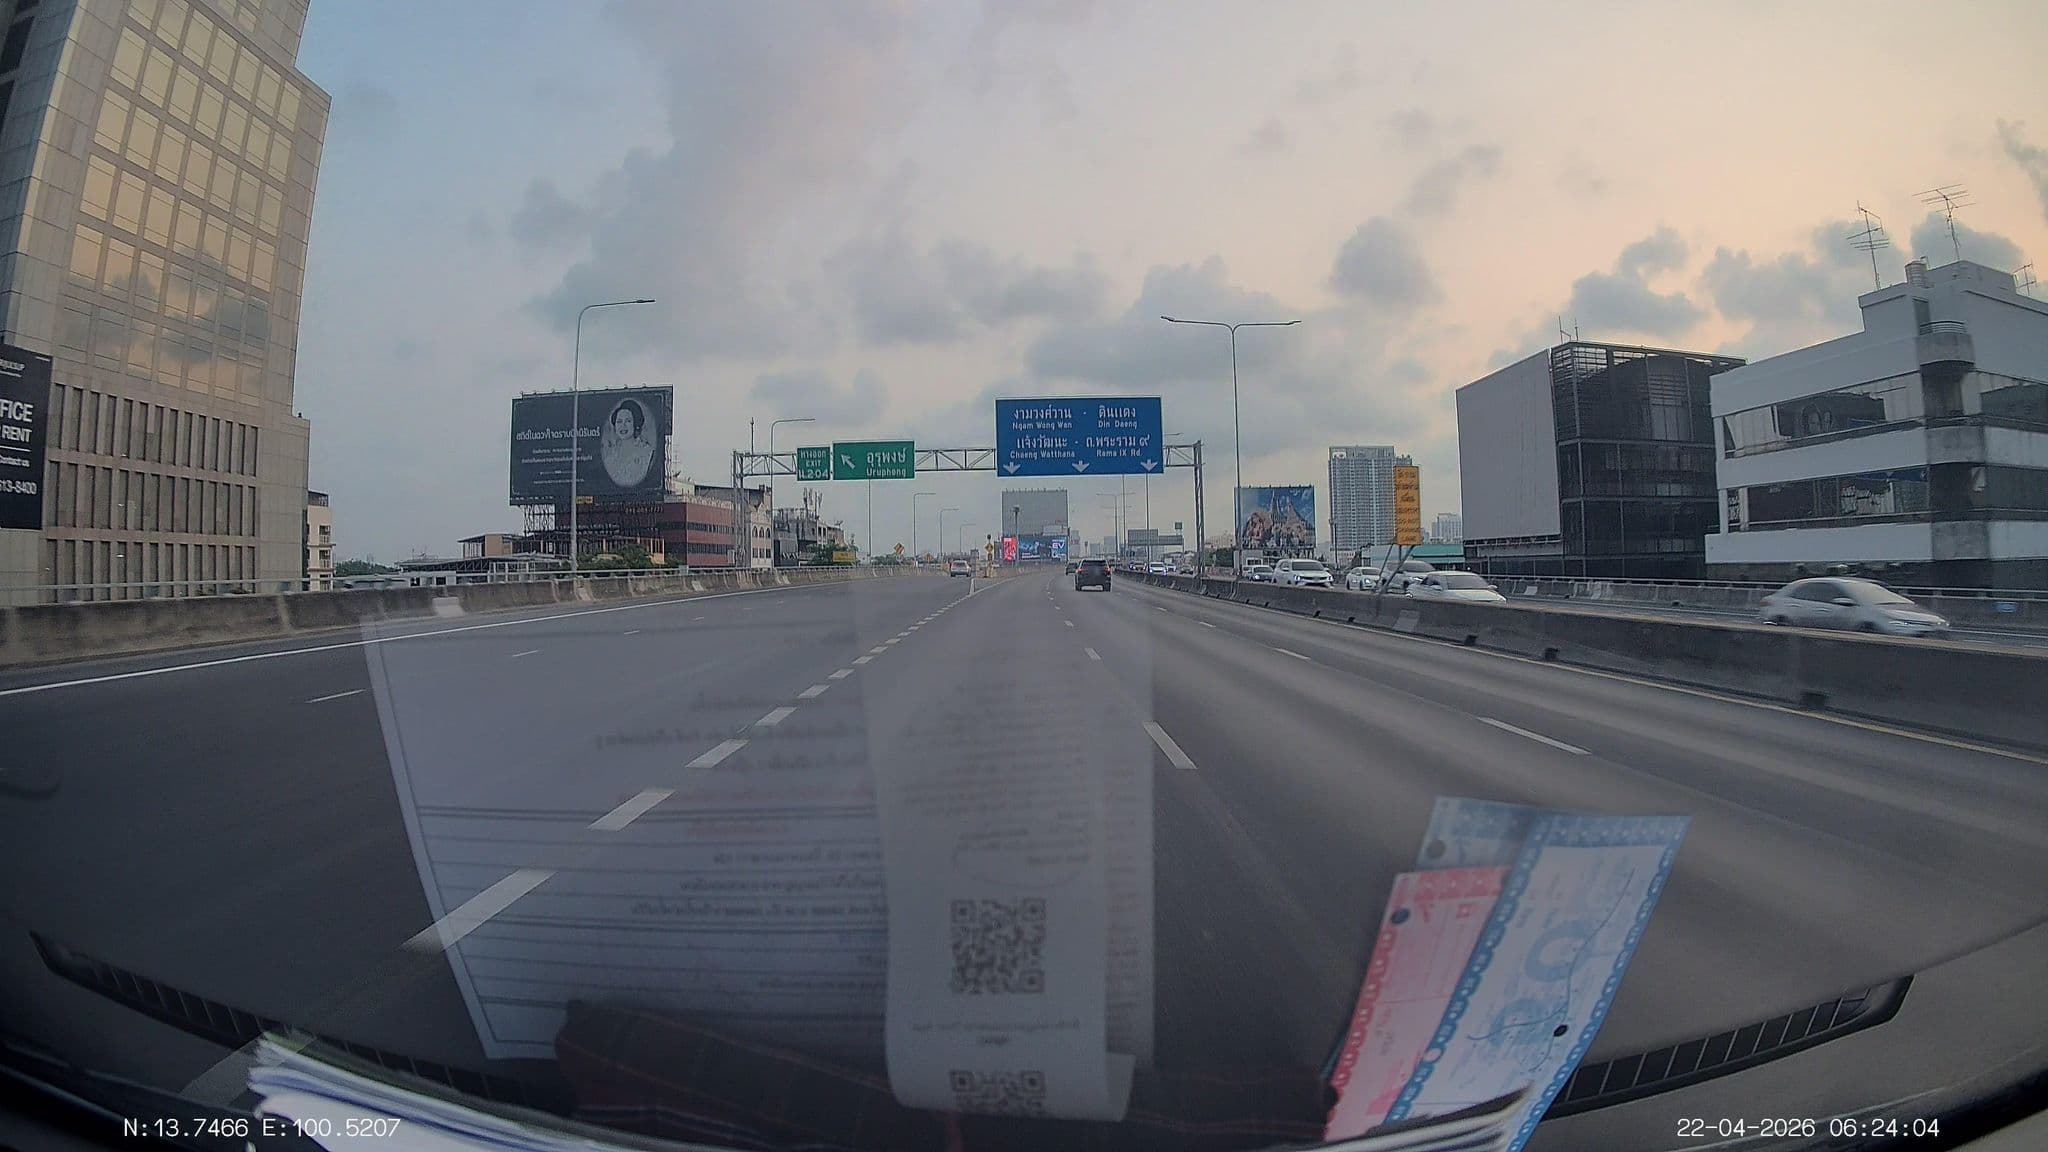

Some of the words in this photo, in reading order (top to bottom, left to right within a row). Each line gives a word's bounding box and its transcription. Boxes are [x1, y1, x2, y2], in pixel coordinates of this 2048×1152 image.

[0, 399, 33, 422] FICE
[1013, 404, 1072, 420] งามวงศ์วาน
[1098, 405, 1136, 418] ดินแดง
[1012, 422, 1034, 431] Ngam
[1036, 422, 1055, 430] Wong
[1057, 421, 1073, 429] Wan
[1098, 420, 1111, 428] Din
[1114, 420, 1138, 429] Daeng
[1, 425, 32, 442] RENT
[1016, 434, 1068, 449] แจ้งวัฒนะ
[1086, 434, 1136, 449] ถ.พระราม
[1139, 434, 1150, 447] ๙
[1010, 451, 1038, 460] Chaeng
[1040, 450, 1075, 458] Watthana
[1096, 449, 1117, 457] Rama
[1119, 449, 1127, 457] IX
[866, 467, 907, 477] Uruphong
